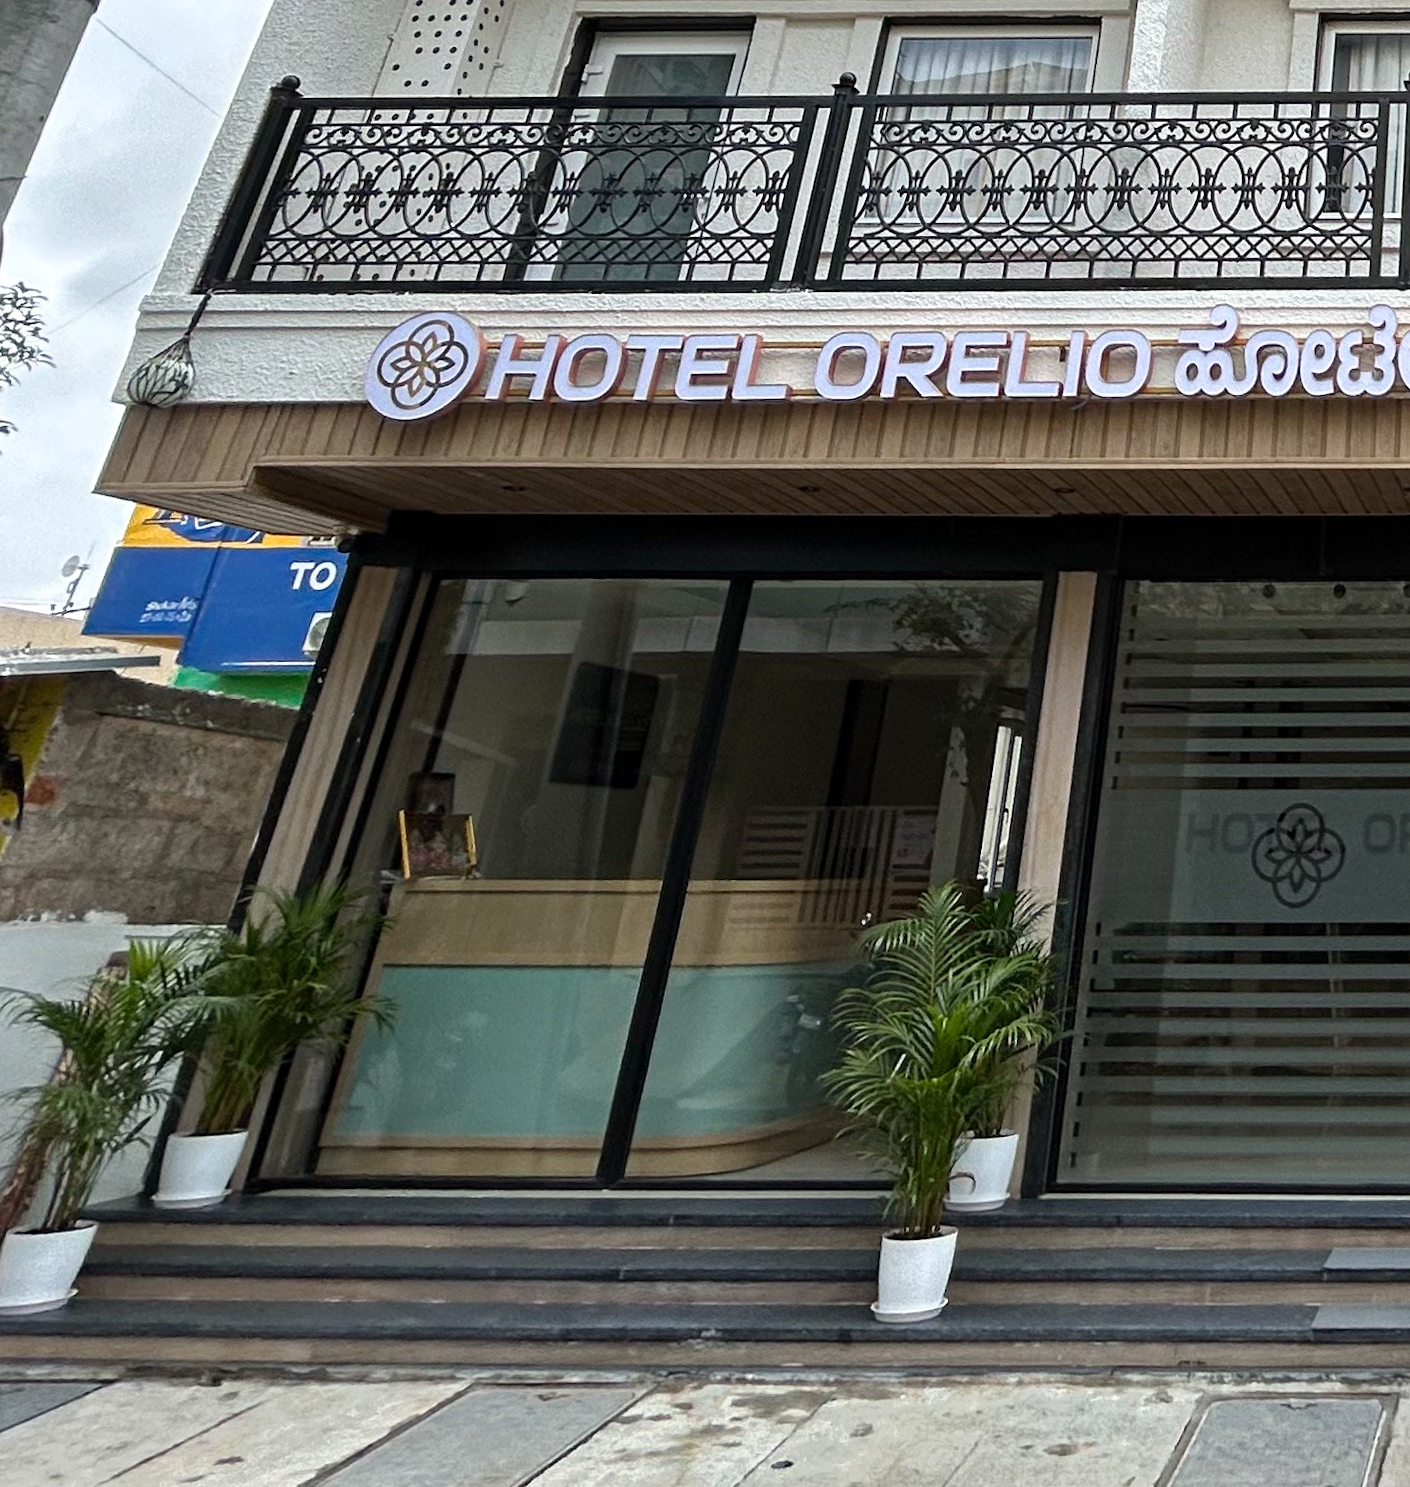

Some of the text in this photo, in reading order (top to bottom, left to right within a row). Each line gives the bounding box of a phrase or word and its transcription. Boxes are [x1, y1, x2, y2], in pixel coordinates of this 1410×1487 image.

[485, 329, 1154, 402] HOTEL ORELIO
[290, 561, 337, 591] TO
